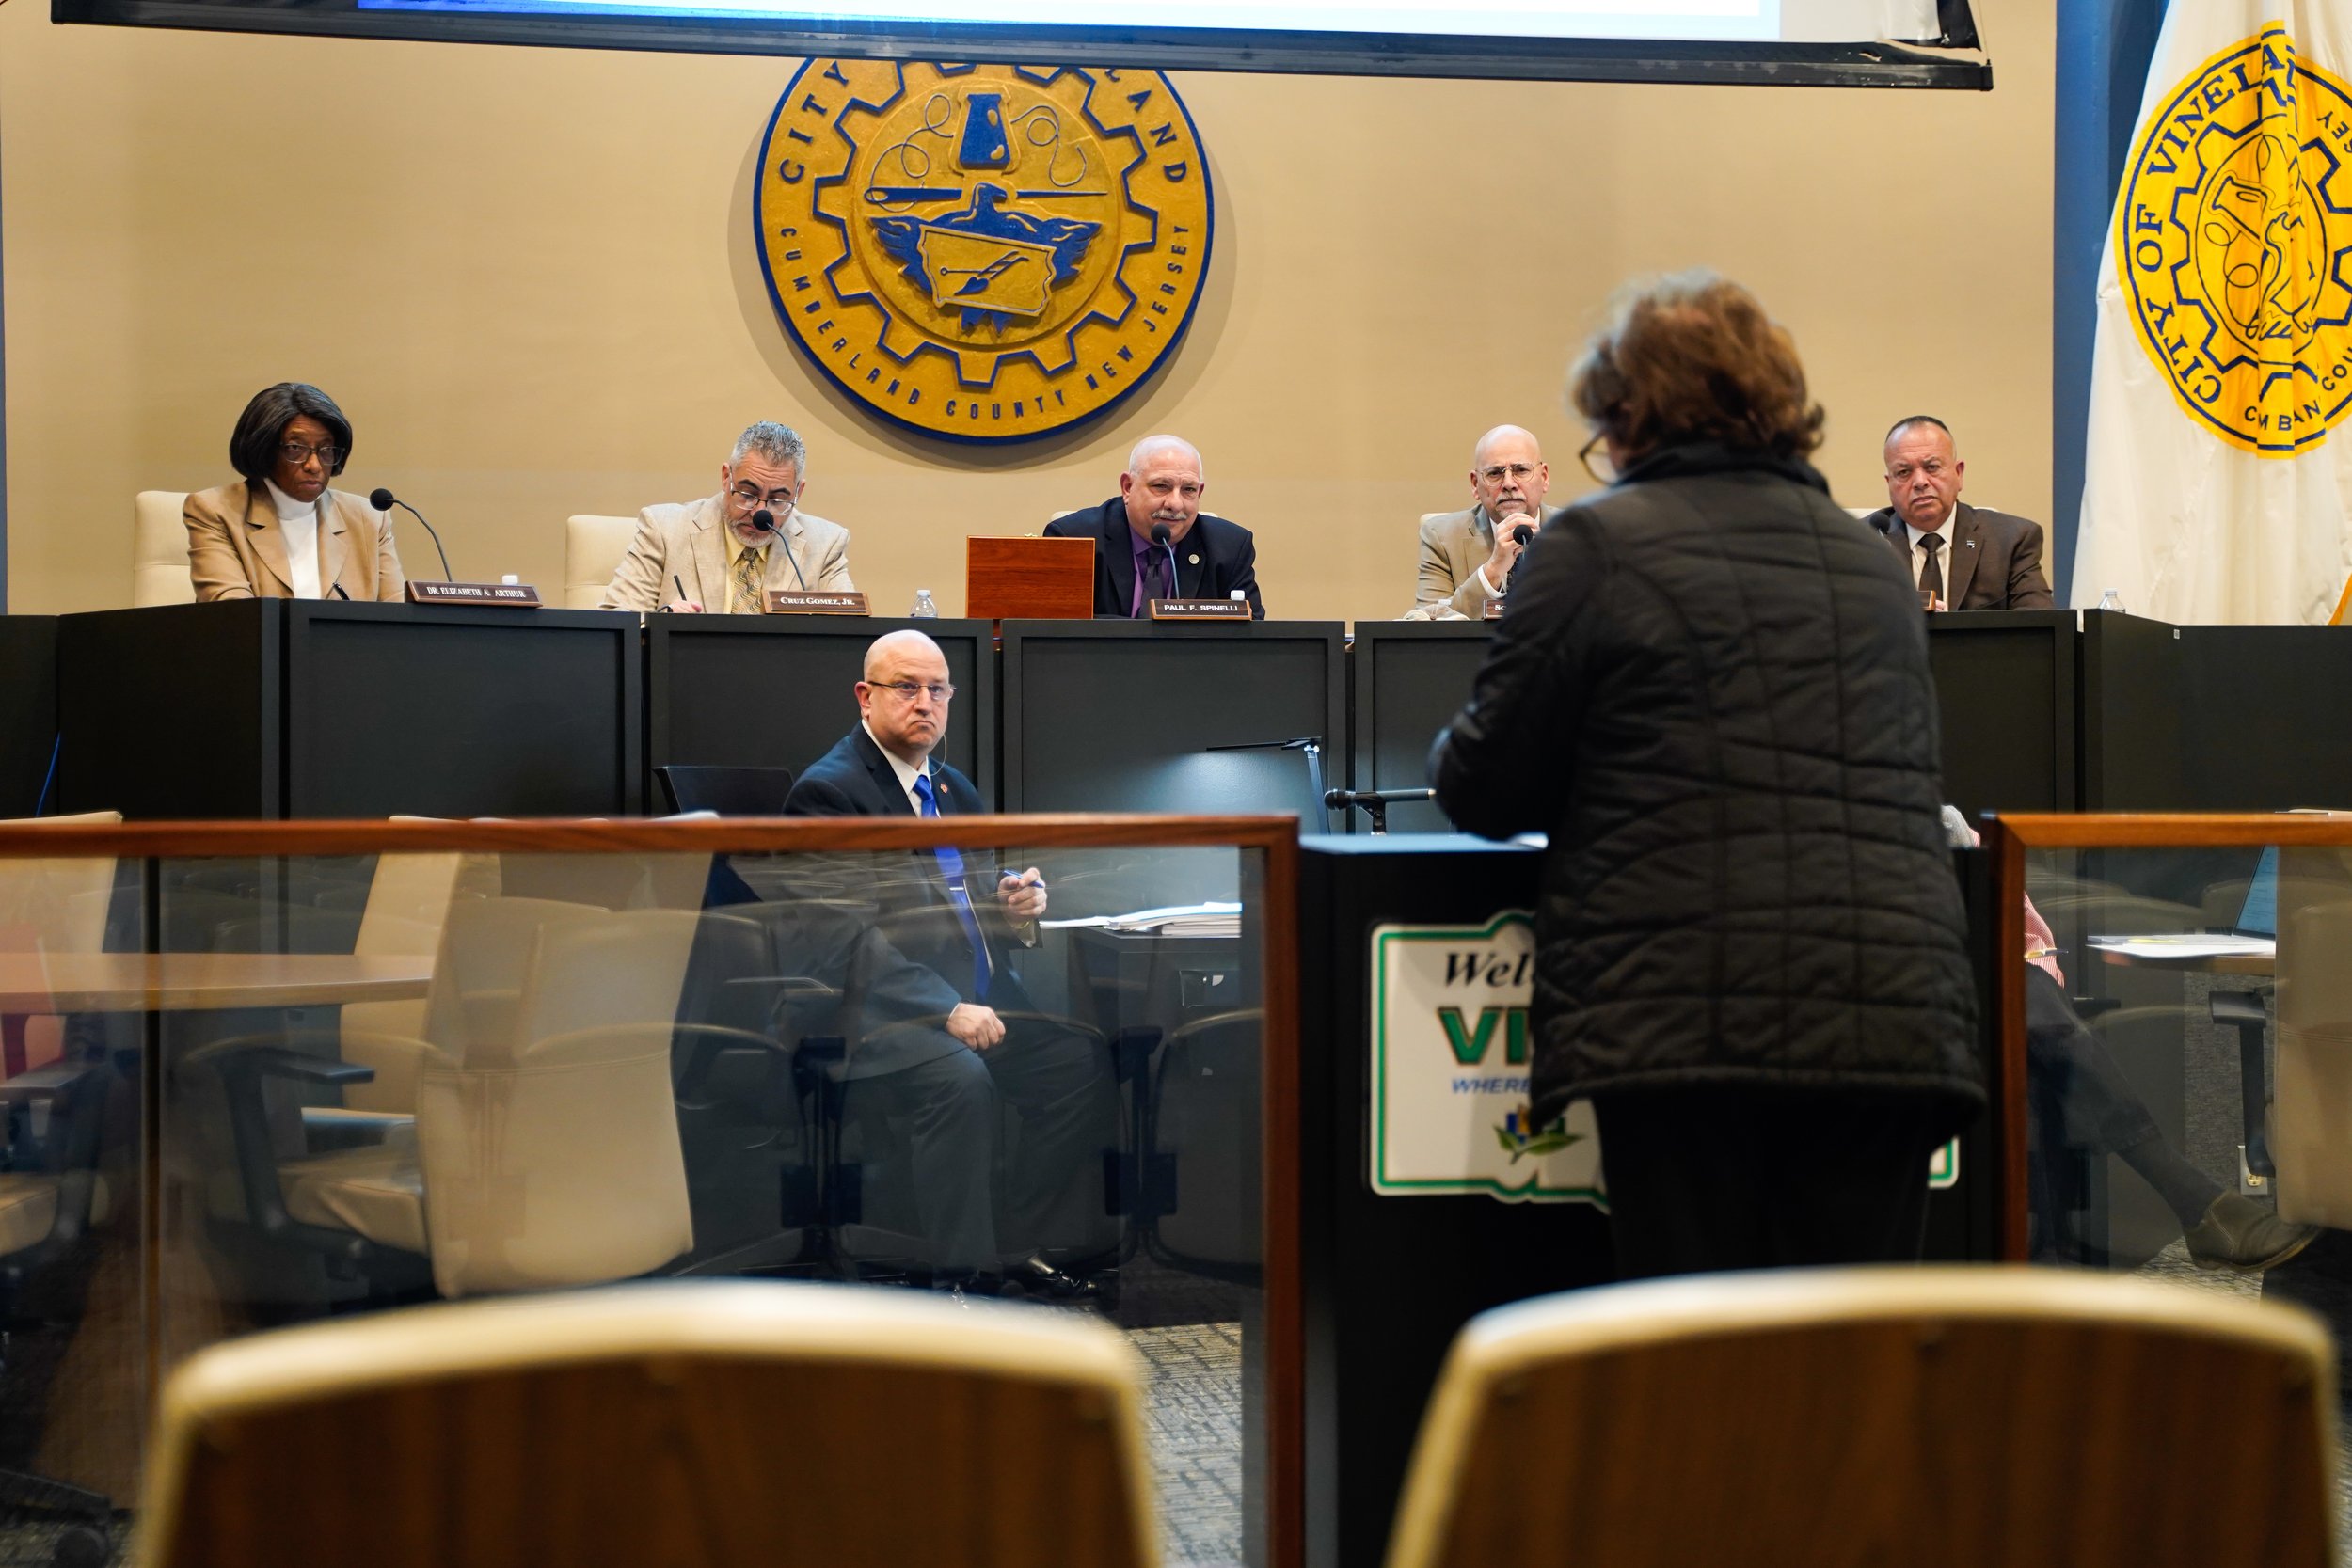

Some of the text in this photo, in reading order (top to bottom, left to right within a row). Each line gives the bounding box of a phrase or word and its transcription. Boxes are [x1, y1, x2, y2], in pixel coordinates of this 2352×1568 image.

[780, 59, 849, 184] CITY
[2136, 204, 2163, 273] OF
[780, 226, 1189, 420] CUMBERLAND COUNTY NEW JERSEY
[2145, 298, 2222, 404] CITY
[426, 586, 439, 594] DR.
[440, 586, 482, 595] ELIZABETH
[495, 590, 526, 598] ARTHUR
[1445, 952, 1530, 987] Wel
[1437, 1006, 1531, 1066] VI
